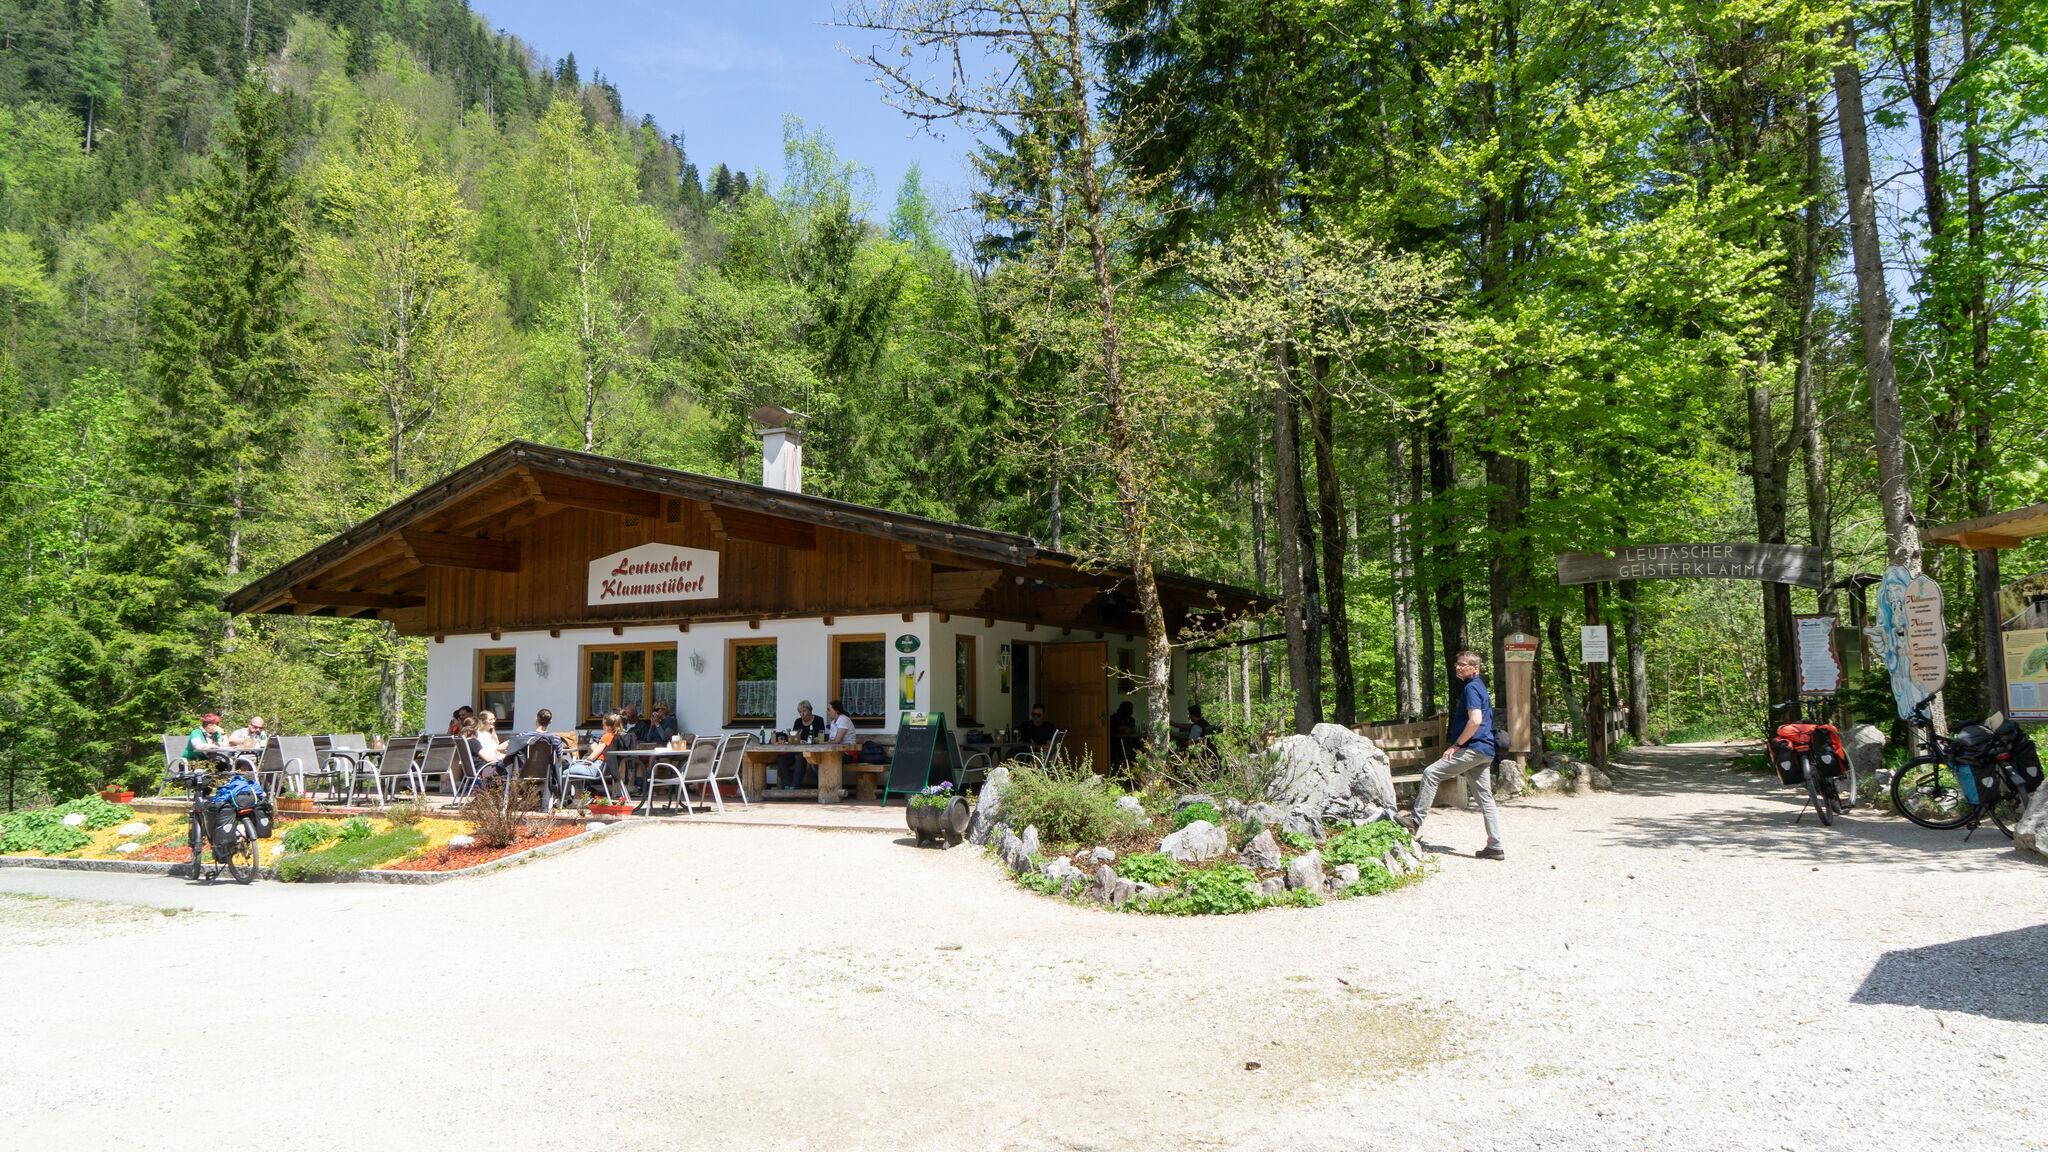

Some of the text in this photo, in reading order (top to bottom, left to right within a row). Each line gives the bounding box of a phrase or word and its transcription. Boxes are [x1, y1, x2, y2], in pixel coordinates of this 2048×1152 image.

[1625, 545, 1734, 562] LEUTASCHER
[611, 555, 693, 577] Leutascher
[1619, 563, 1755, 578] GEISTERKLAMM
[600, 575, 705, 600] Klammstüberl
